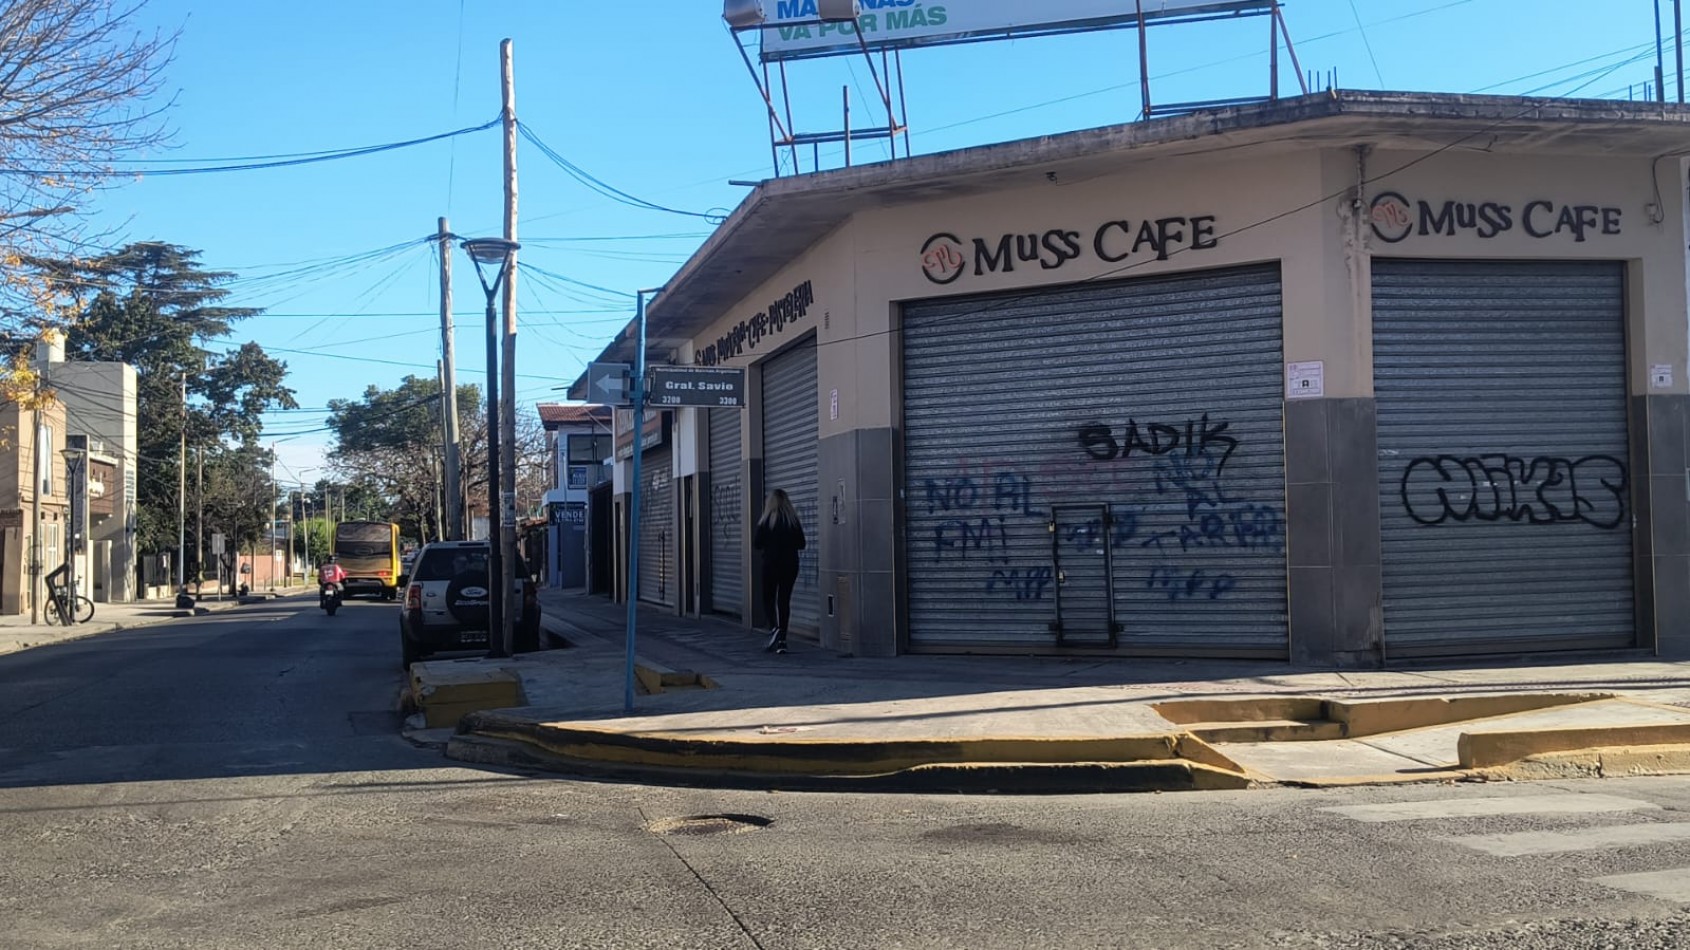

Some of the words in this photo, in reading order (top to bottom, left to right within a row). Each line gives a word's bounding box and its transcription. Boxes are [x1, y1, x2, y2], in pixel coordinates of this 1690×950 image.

[778, 23, 811, 41] VA
[819, 14, 877, 37] POR
[886, 4, 948, 31] MÁS
[1094, 215, 1218, 262] CAFE
[1523, 200, 1622, 242] CAFE
[698, 381, 734, 391] Savio
[555, 510, 584, 518] VENDE
